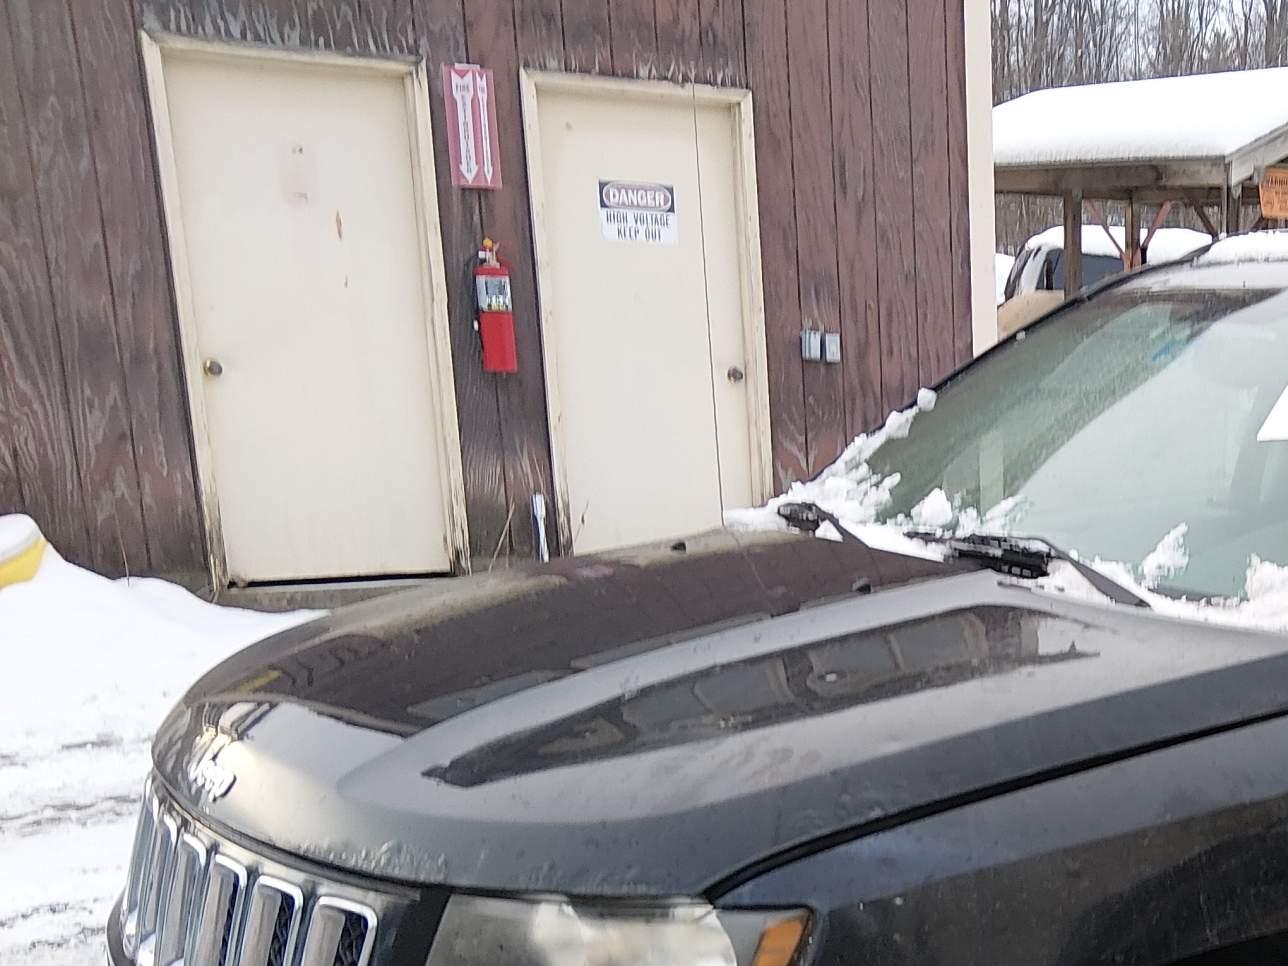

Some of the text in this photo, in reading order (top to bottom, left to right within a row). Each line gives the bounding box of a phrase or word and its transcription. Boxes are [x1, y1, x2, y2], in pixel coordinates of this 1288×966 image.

[609, 187, 665, 207] DANGER
[606, 210, 670, 229] HIGH VOLTAGE
[617, 226, 662, 242] KEEP OUT
